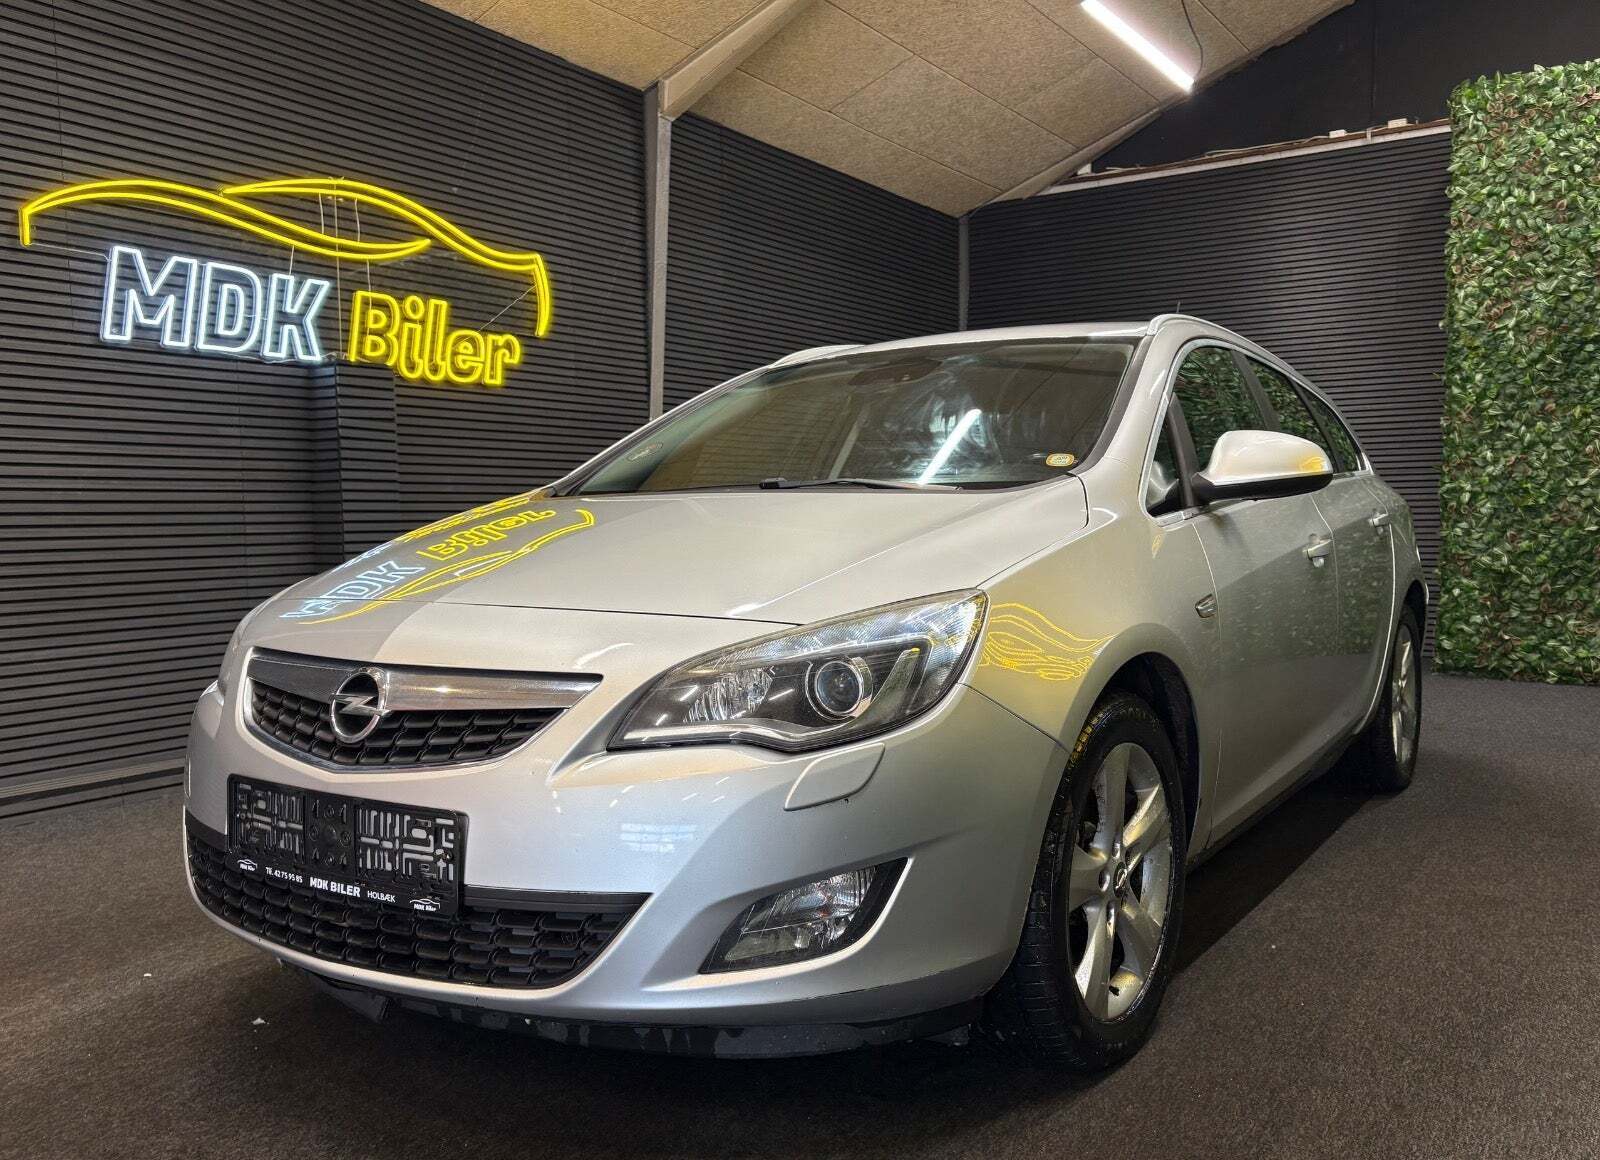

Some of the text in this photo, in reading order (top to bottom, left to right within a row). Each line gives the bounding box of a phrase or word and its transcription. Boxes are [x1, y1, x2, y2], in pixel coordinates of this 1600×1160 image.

[101, 245, 522, 386] MDK Biler
[274, 869, 281, 878] 42
[281, 871, 288, 880] 75
[309, 876, 361, 897] MDK BILER
[367, 890, 396, 903] HOLBÆK
